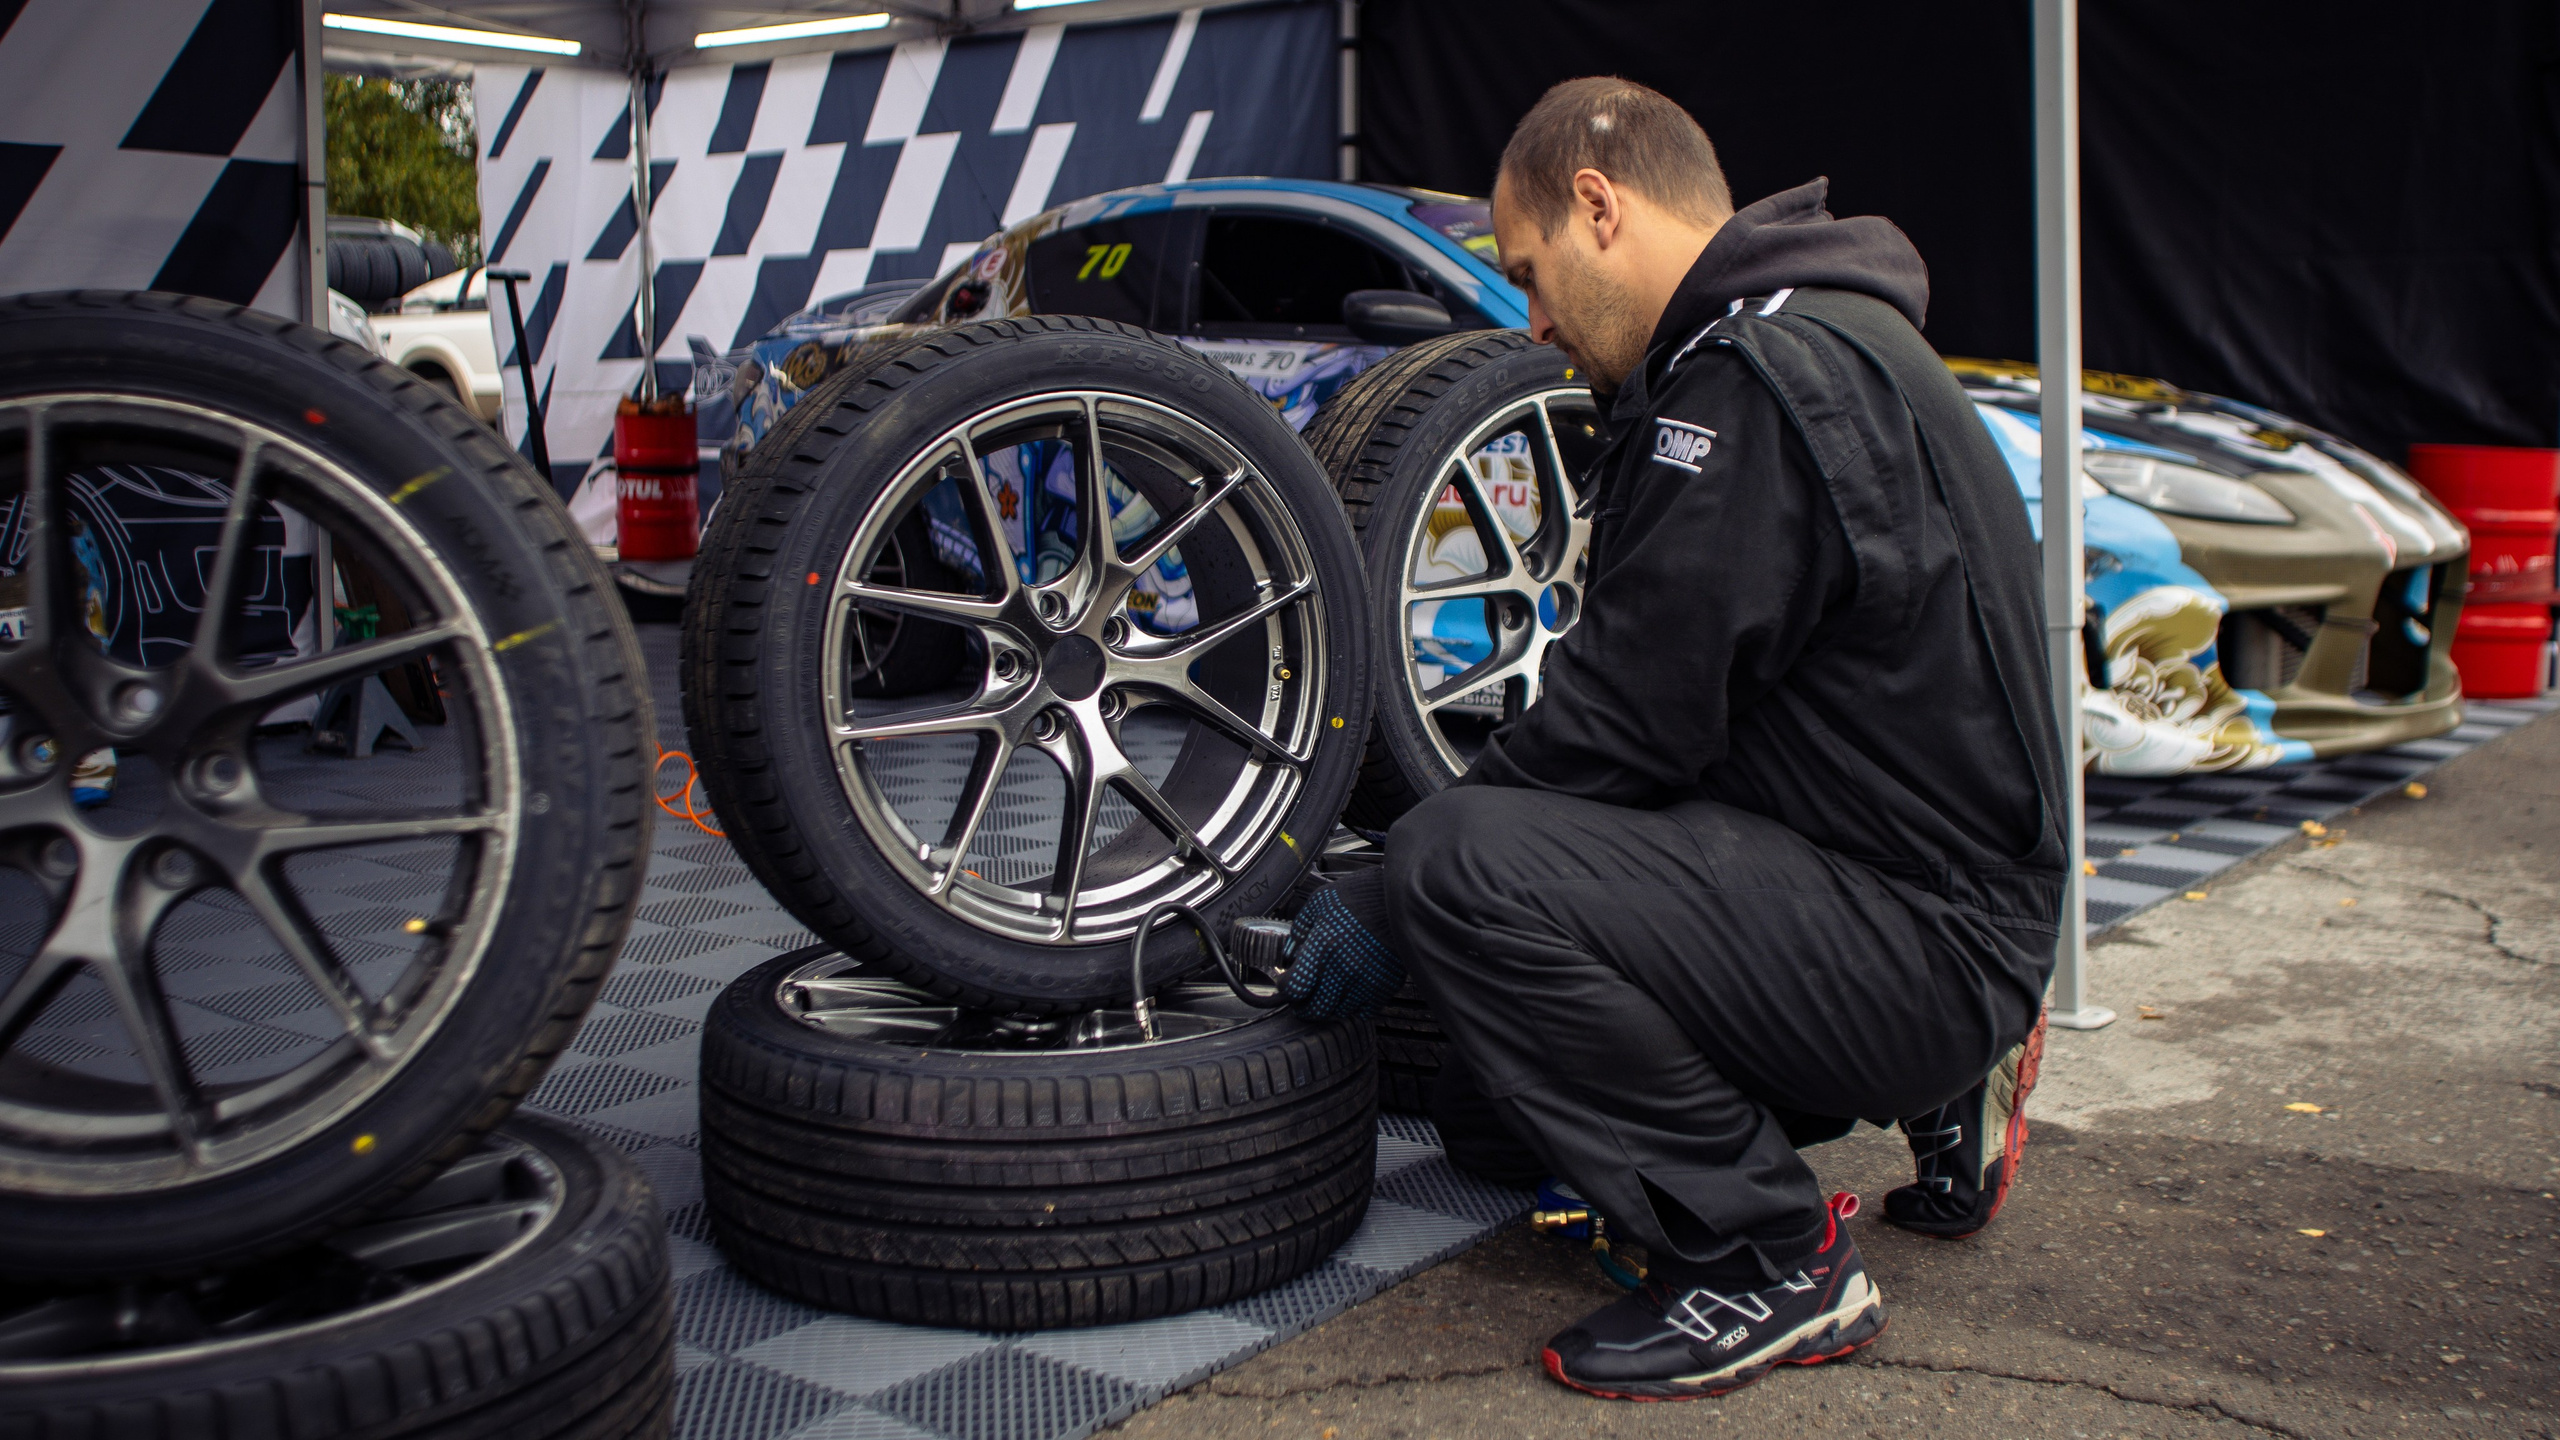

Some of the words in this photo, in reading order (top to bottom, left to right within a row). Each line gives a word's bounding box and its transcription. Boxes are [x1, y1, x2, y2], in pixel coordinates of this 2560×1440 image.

[1077, 243, 1133, 281] 70
[1261, 350, 1297, 371] 70
[1657, 426, 1712, 463] OMP
[618, 478, 663, 500] OTUL
